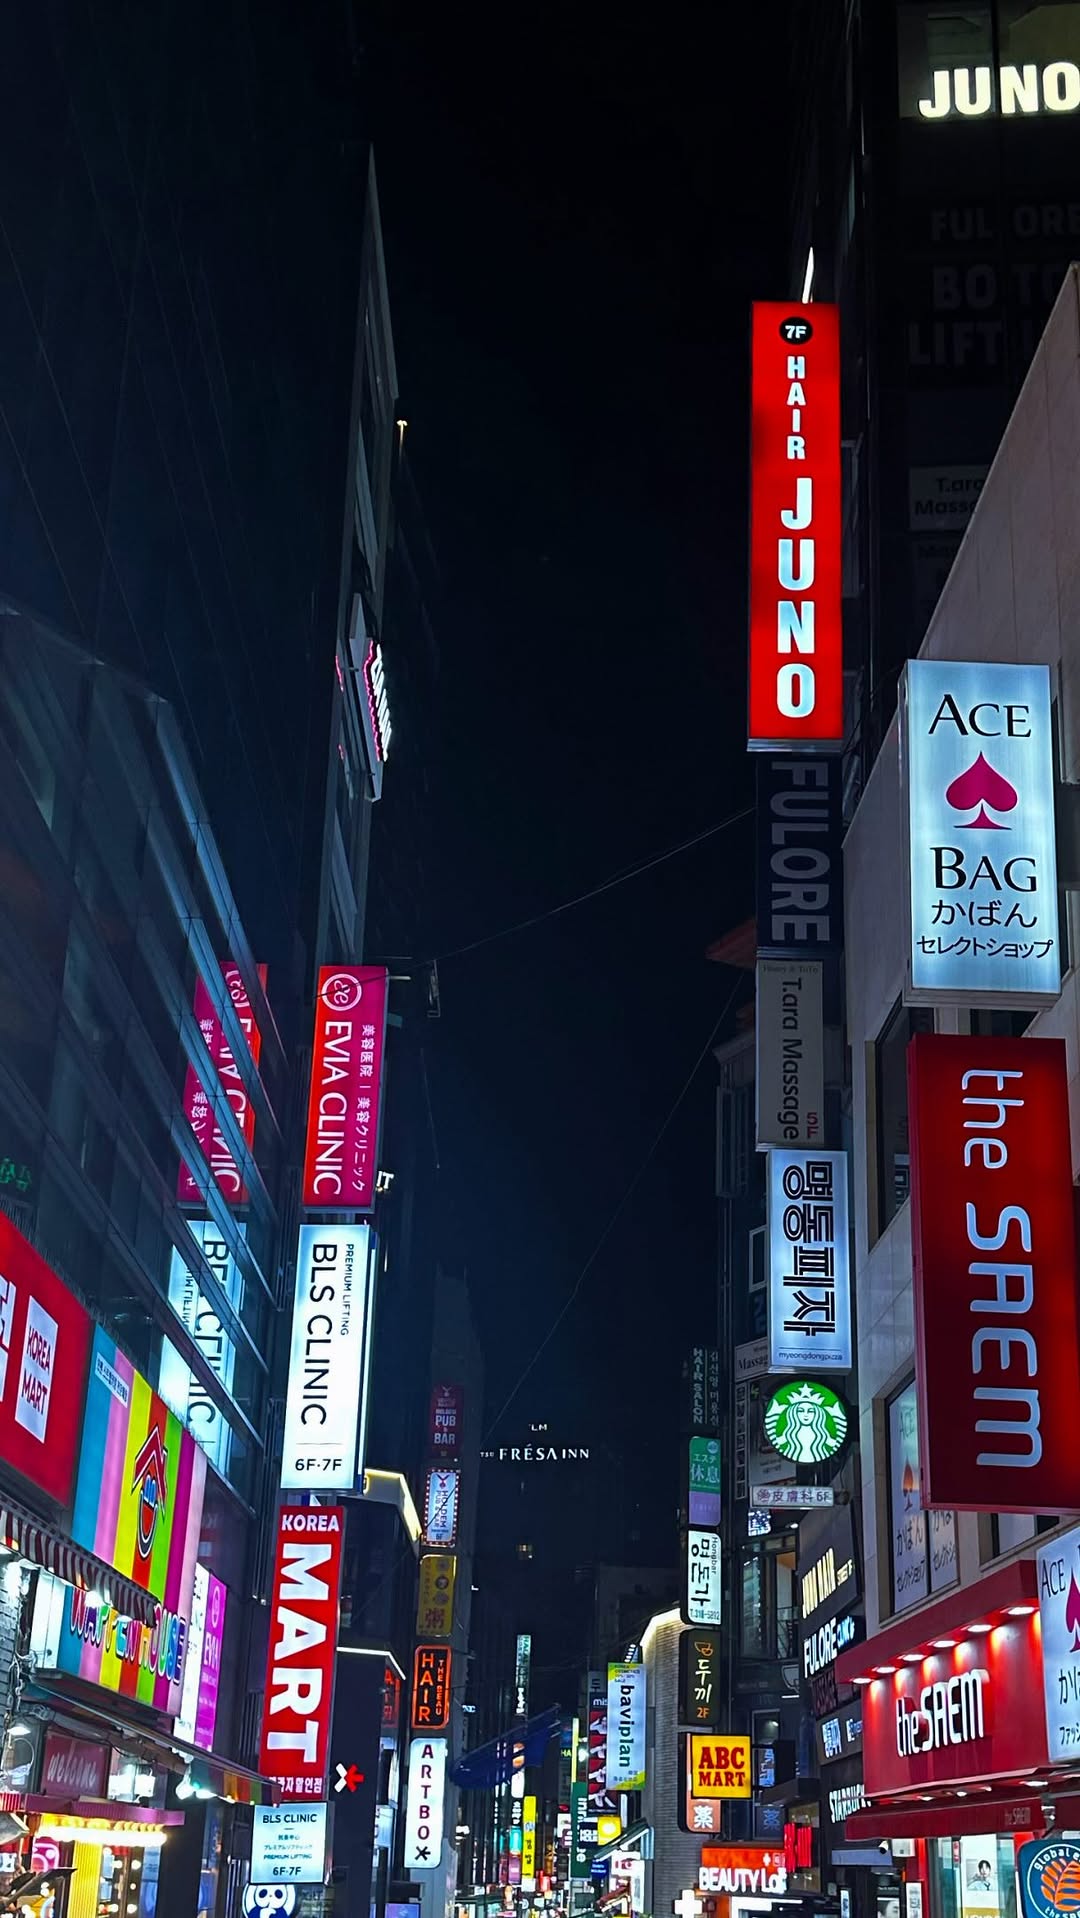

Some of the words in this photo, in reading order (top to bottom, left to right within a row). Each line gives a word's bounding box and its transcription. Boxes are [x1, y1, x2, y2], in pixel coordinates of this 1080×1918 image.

[918, 62, 1080, 118] JUNO
[784, 324, 807, 339] 7F
[786, 356, 807, 460] HAIR
[776, 477, 816, 718] JUNO
[928, 694, 1032, 738] ACE
[770, 761, 830, 942] FULORE
[930, 847, 1038, 892] BAG
[931, 901, 1038, 928] かばん
[916, 934, 1054, 959] セレクトショップ
[782, 977, 802, 1030] T.ara
[321, 1021, 352, 1084] EVIA
[359, 1024, 375, 1077] 美容医院
[777, 1039, 803, 1140] Massage
[962, 1068, 1024, 1169] the
[312, 1091, 347, 1195] CLINIC
[351, 1097, 372, 1191] 美容クリニック
[343, 1243, 354, 1292] PREMIUM
[782, 1160, 836, 1337] 명동피자
[309, 1244, 338, 1302] BLS
[340, 1294, 351, 1336] LIFTING
[25, 1325, 51, 1377] KOREA
[300, 1315, 333, 1425] CLINIC
[21, 1368, 47, 1416] MART
[433, 1432, 456, 1445] BAR
[435, 1415, 456, 1427] PUB
[498, 1443, 558, 1461] FRÉSA
[561, 1448, 590, 1460] INN
[690, 1463, 720, 1484] 休息
[282, 1515, 339, 1531] KOREA
[690, 1538, 711, 1606] 명돈가
[1041, 1558, 1066, 1601] ACE
[266, 1543, 332, 1763] MART
[803, 1617, 838, 1679] FULORE
[419, 1653, 434, 1722] HAIR
[694, 1659, 713, 1704] 두끼
[618, 1685, 635, 1767] baviplan
[696, 1706, 711, 1719] 2F
[698, 1746, 745, 1770] ABC
[698, 1771, 745, 1787] MART
[263, 1814, 281, 1824] BLS
[284, 1813, 317, 1823] CLINIC
[693, 1804, 714, 1830] 薬
[699, 1867, 760, 1893] BEAUTY
[1034, 1847, 1070, 1871] global
